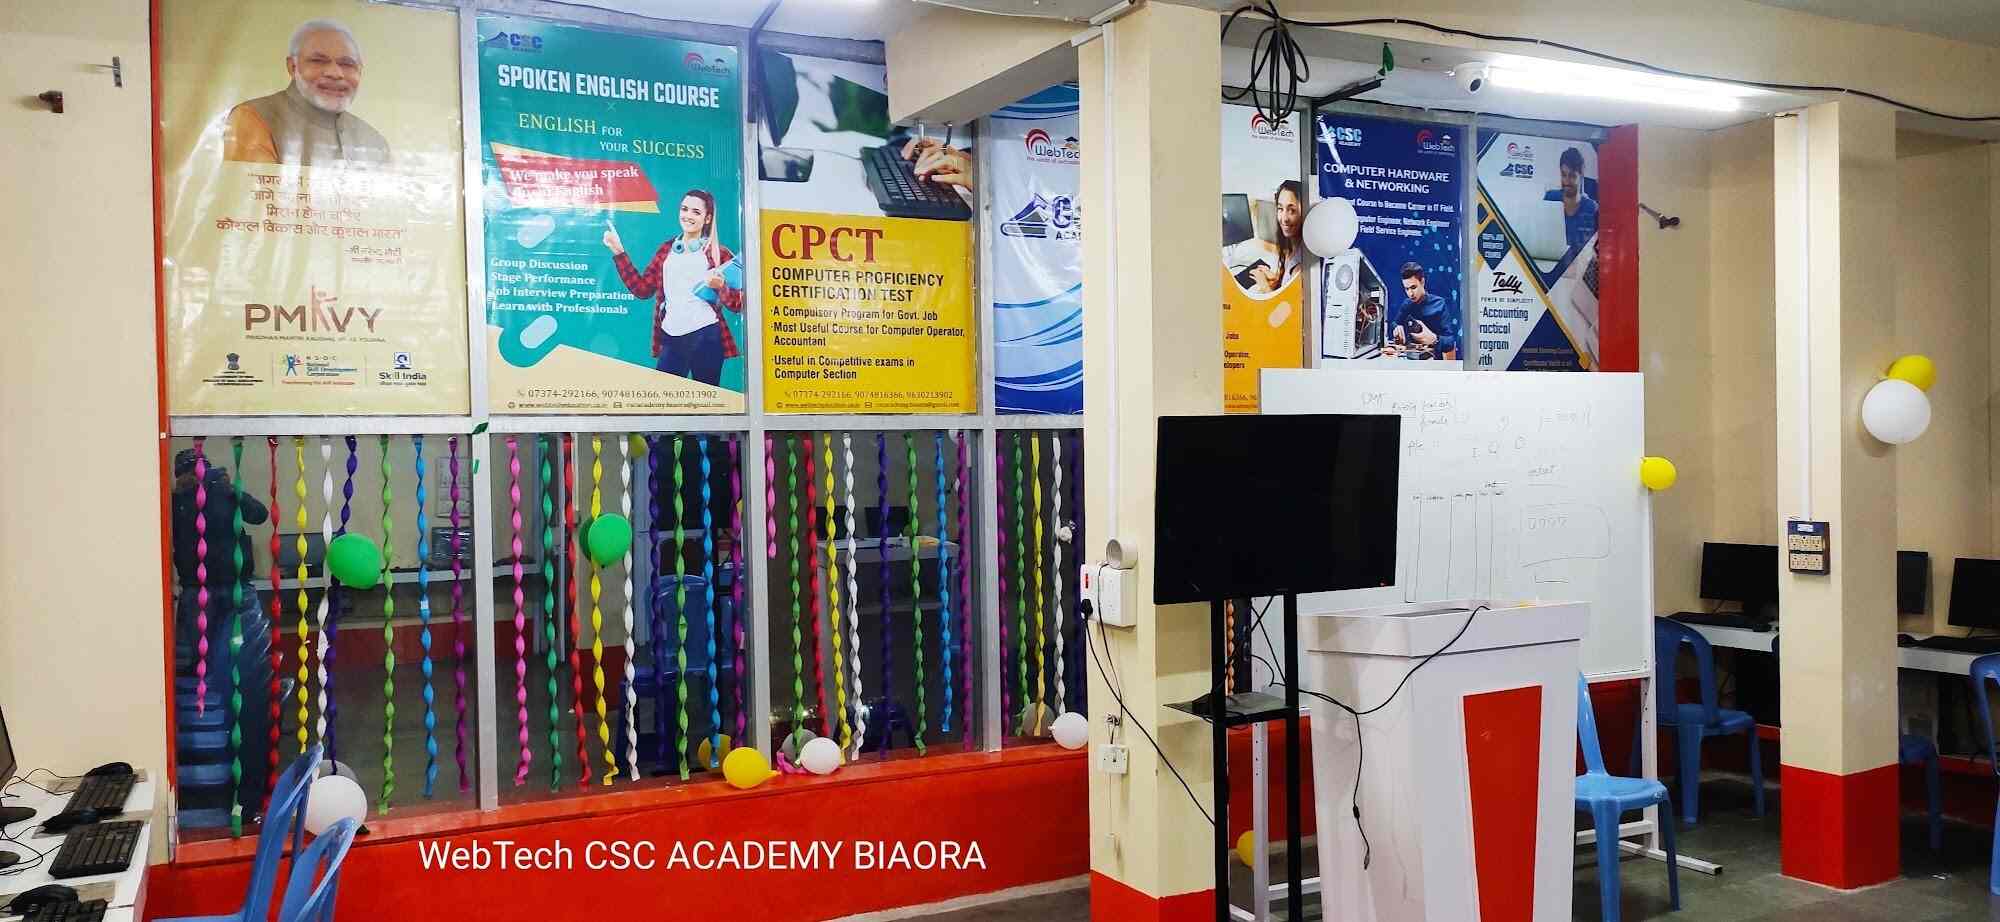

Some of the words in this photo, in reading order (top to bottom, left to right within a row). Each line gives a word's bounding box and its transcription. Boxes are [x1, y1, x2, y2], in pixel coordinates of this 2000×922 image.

[497, 64, 571, 93] SPOKEN
[576, 73, 649, 101] ENGLISH
[654, 82, 720, 108] COURSE
[519, 114, 597, 135] ENGLISH
[601, 126, 624, 137] FOR
[1337, 126, 1362, 143] CSC
[600, 142, 628, 153] YOUR
[633, 139, 705, 159] SUCCESS
[574, 170, 598, 183] you
[601, 166, 640, 183] speak
[1323, 163, 1385, 178] COMPUTER
[1387, 168, 1450, 183] HARDWARE
[1515, 163, 1534, 176] CSC
[1344, 178, 1354, 188] &
[1356, 179, 1430, 194] NETWORKING
[1356, 198, 1377, 208] Course
[1385, 200, 1407, 210] Become
[216, 217, 260, 232] कौशल
[264, 220, 303, 233] विकास
[331, 226, 369, 240] कुशल
[1360, 225, 1375, 233] Field
[1376, 226, 1396, 235] Service
[771, 223, 884, 264] CPCT
[490, 257, 526, 271] Group
[529, 258, 588, 271] Discussion
[491, 272, 522, 284] Stage
[525, 274, 596, 286] Performance
[772, 267, 850, 282] COMPUTER
[856, 271, 944, 288] PROFICIENCY
[1493, 272, 1523, 292] Tally
[513, 286, 568, 299] Interview
[570, 289, 635, 302] Preparation
[772, 284, 877, 301] CERTIFICATION
[881, 289, 913, 302] TEST
[492, 301, 526, 312] Learn
[526, 301, 553, 312] with
[555, 303, 629, 315] Professionals
[783, 306, 838, 321] Compulsory
[841, 309, 880, 321] Program
[883, 309, 894, 320] for
[898, 310, 920, 320] Govt.
[922, 310, 938, 321] Job
[774, 322, 797, 333] Most
[800, 323, 829, 334] Useful
[832, 324, 864, 335] Course
[867, 325, 879, 335] for
[881, 325, 924, 337] Computer
[927, 326, 965, 338] Operator,
[774, 336, 826, 347] Accountant
[774, 355, 804, 366] Useful
[807, 355, 816, 366] in
[819, 356, 873, 369] Competitive
[875, 357, 904, 368] exams
[907, 357, 915, 367] in
[402, 372, 428, 381] India
[774, 368, 820, 381] Computer
[823, 369, 857, 380] Section
